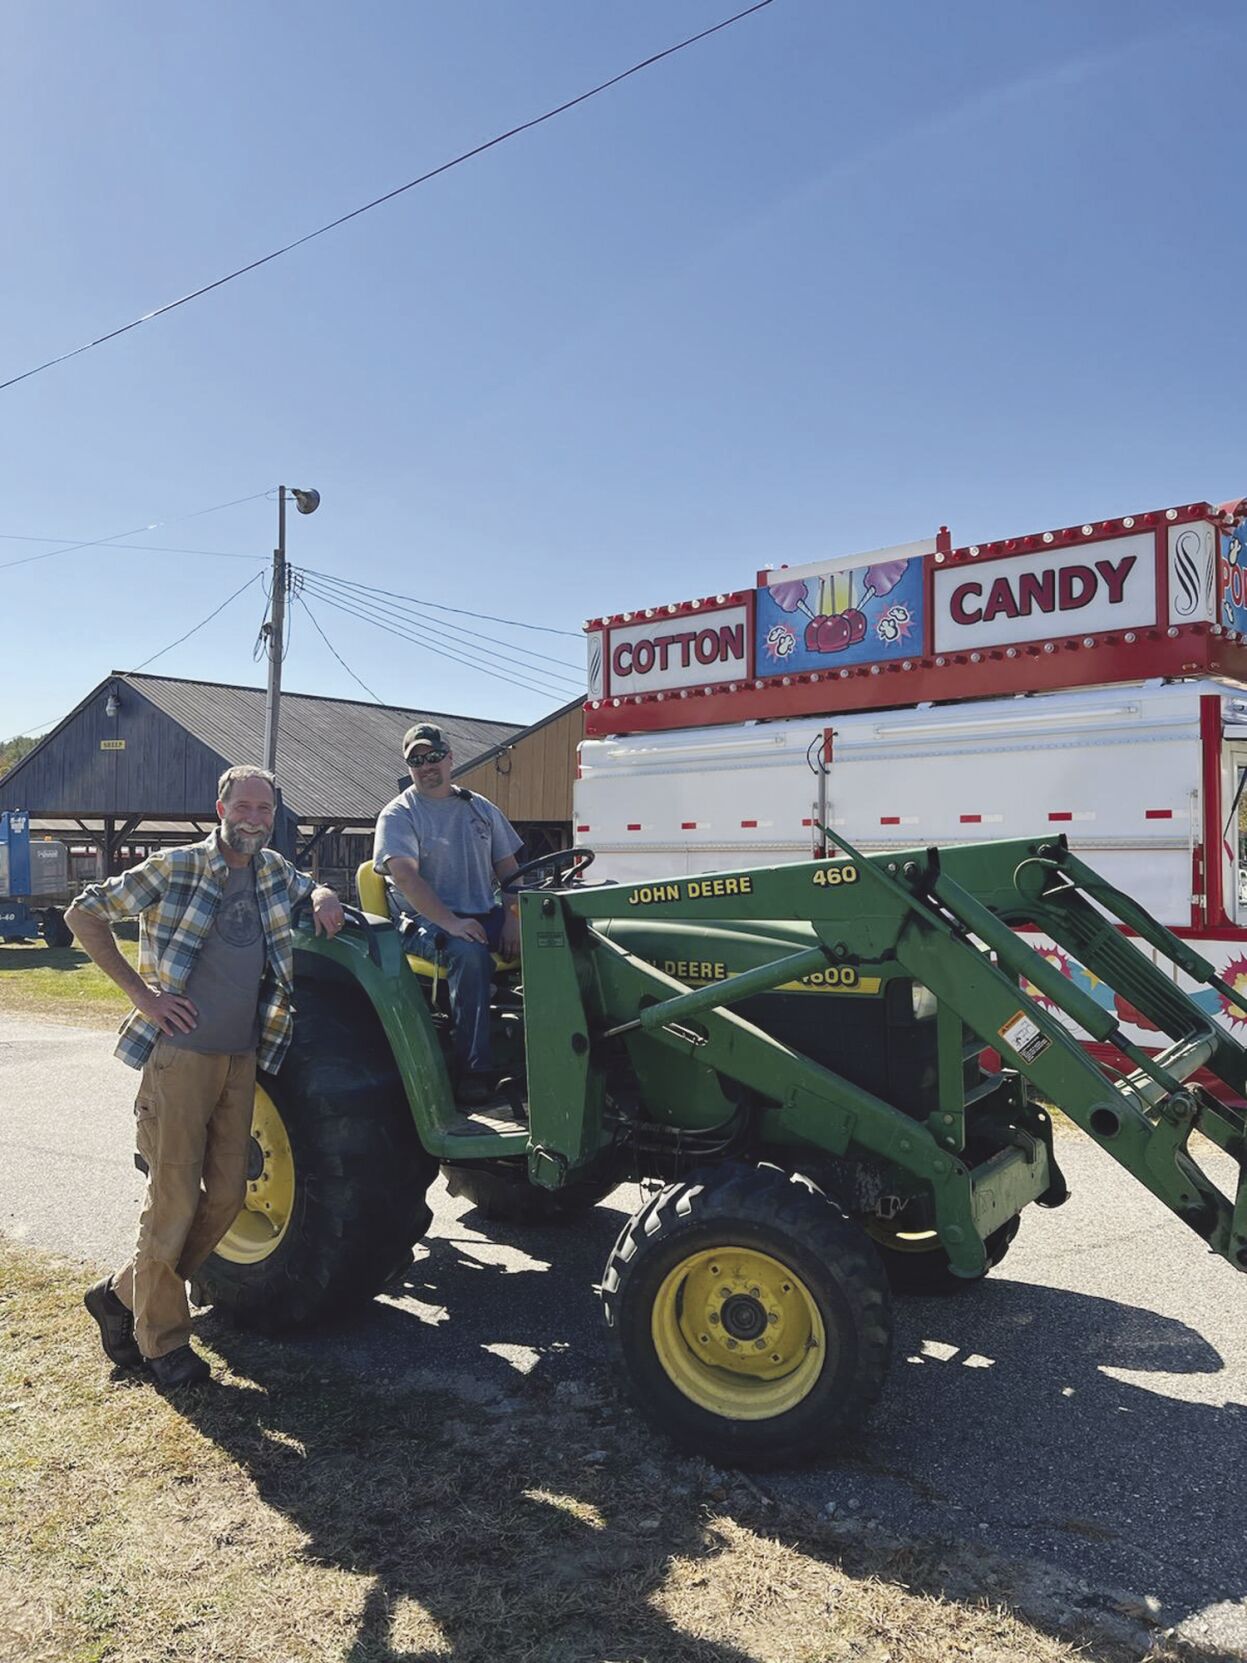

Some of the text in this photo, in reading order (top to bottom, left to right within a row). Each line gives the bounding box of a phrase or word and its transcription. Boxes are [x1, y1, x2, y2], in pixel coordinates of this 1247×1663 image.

[612, 555, 1137, 676] COTTON CANDY
[812, 865, 858, 887] 460
[629, 876, 751, 905] JOHN DEERE
[664, 960, 725, 979] DEERE
